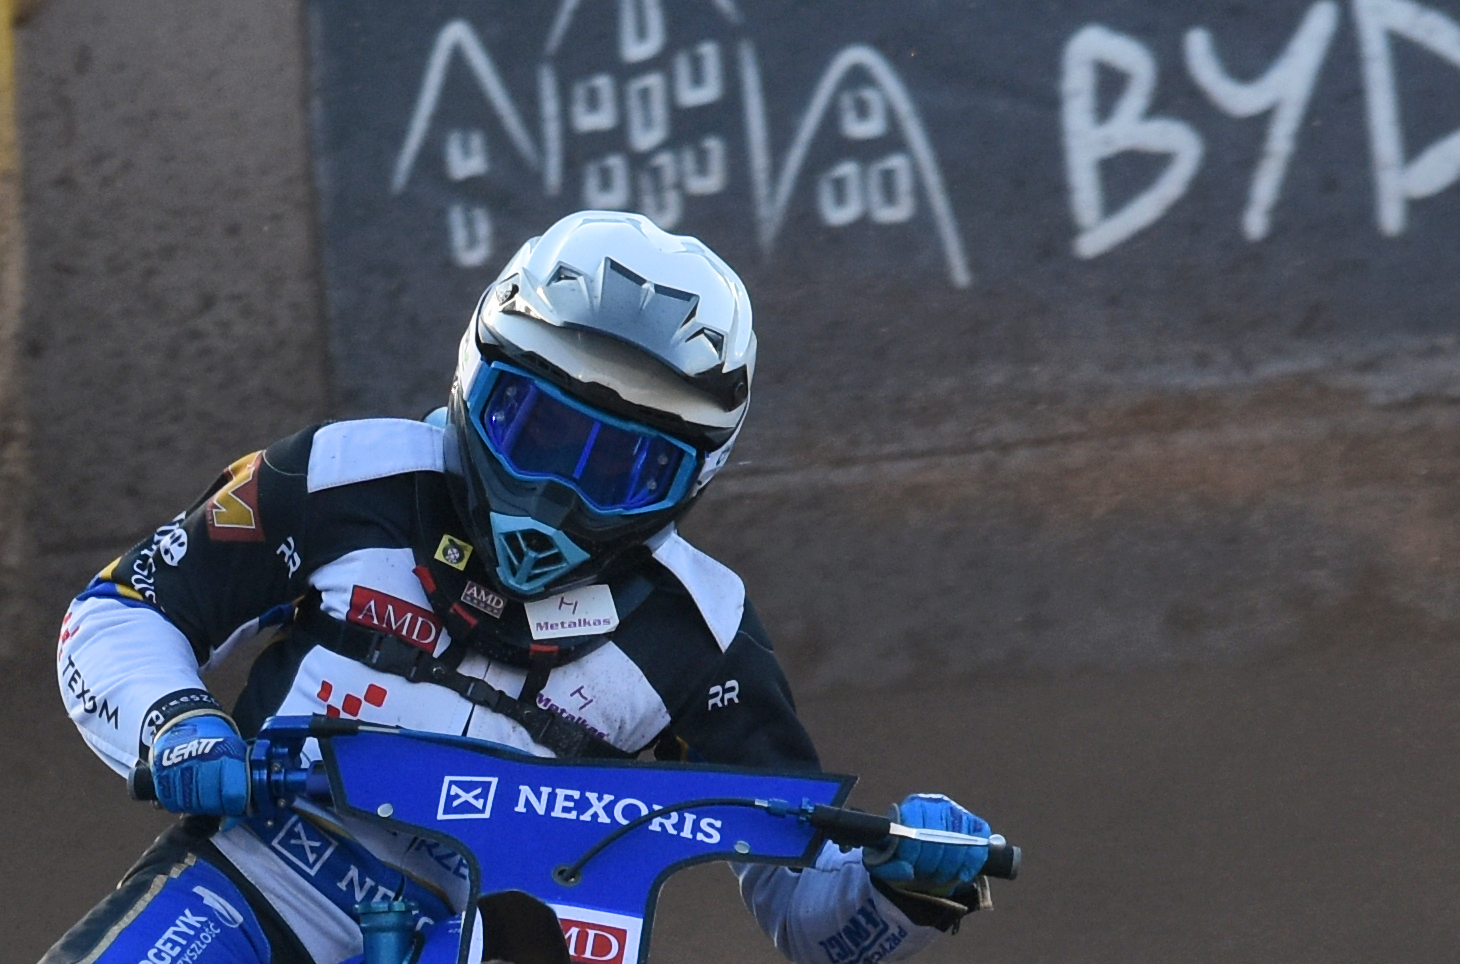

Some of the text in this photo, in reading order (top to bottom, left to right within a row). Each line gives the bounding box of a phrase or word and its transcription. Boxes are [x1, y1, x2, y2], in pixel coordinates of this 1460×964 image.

[467, 586, 504, 609] AMD
[358, 599, 436, 644] AMD
[536, 617, 612, 632] Metalkas
[62, 654, 119, 730] TEXOM
[708, 679, 739, 711] RR
[162, 738, 224, 767] LEATT
[514, 785, 722, 844] NEXORIS
